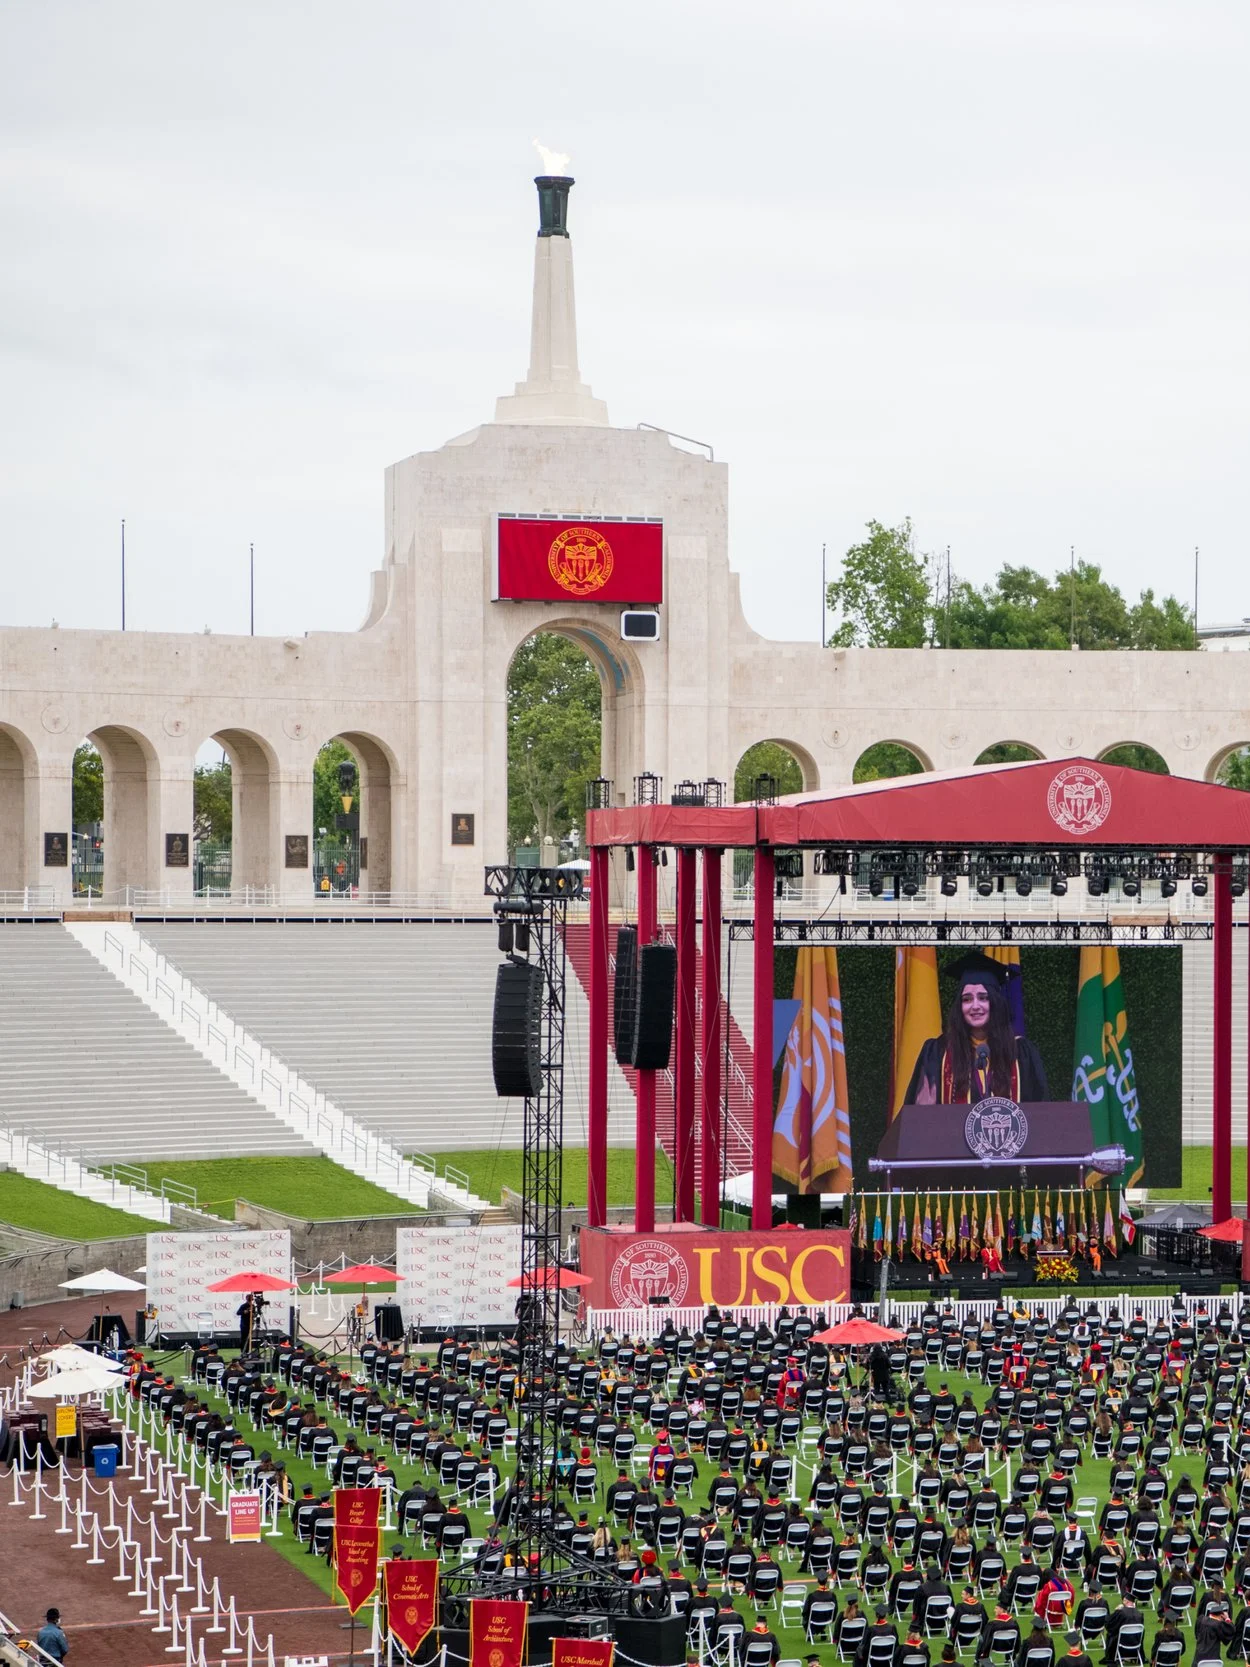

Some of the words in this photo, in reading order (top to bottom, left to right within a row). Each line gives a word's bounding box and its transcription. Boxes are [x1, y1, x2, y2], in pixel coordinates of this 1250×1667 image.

[489, 1270, 505, 1278] USC
[612, 1262, 624, 1302] UNIVERSITY
[626, 1249, 634, 1257] OF
[636, 1242, 674, 1255] SOUTHERN
[674, 1260, 687, 1301] CALIFORNIA
[693, 1244, 846, 1306] USC
[492, 1616, 506, 1624] USC
[503, 1626, 512, 1635] of
[577, 1656, 604, 1666] Marshall
